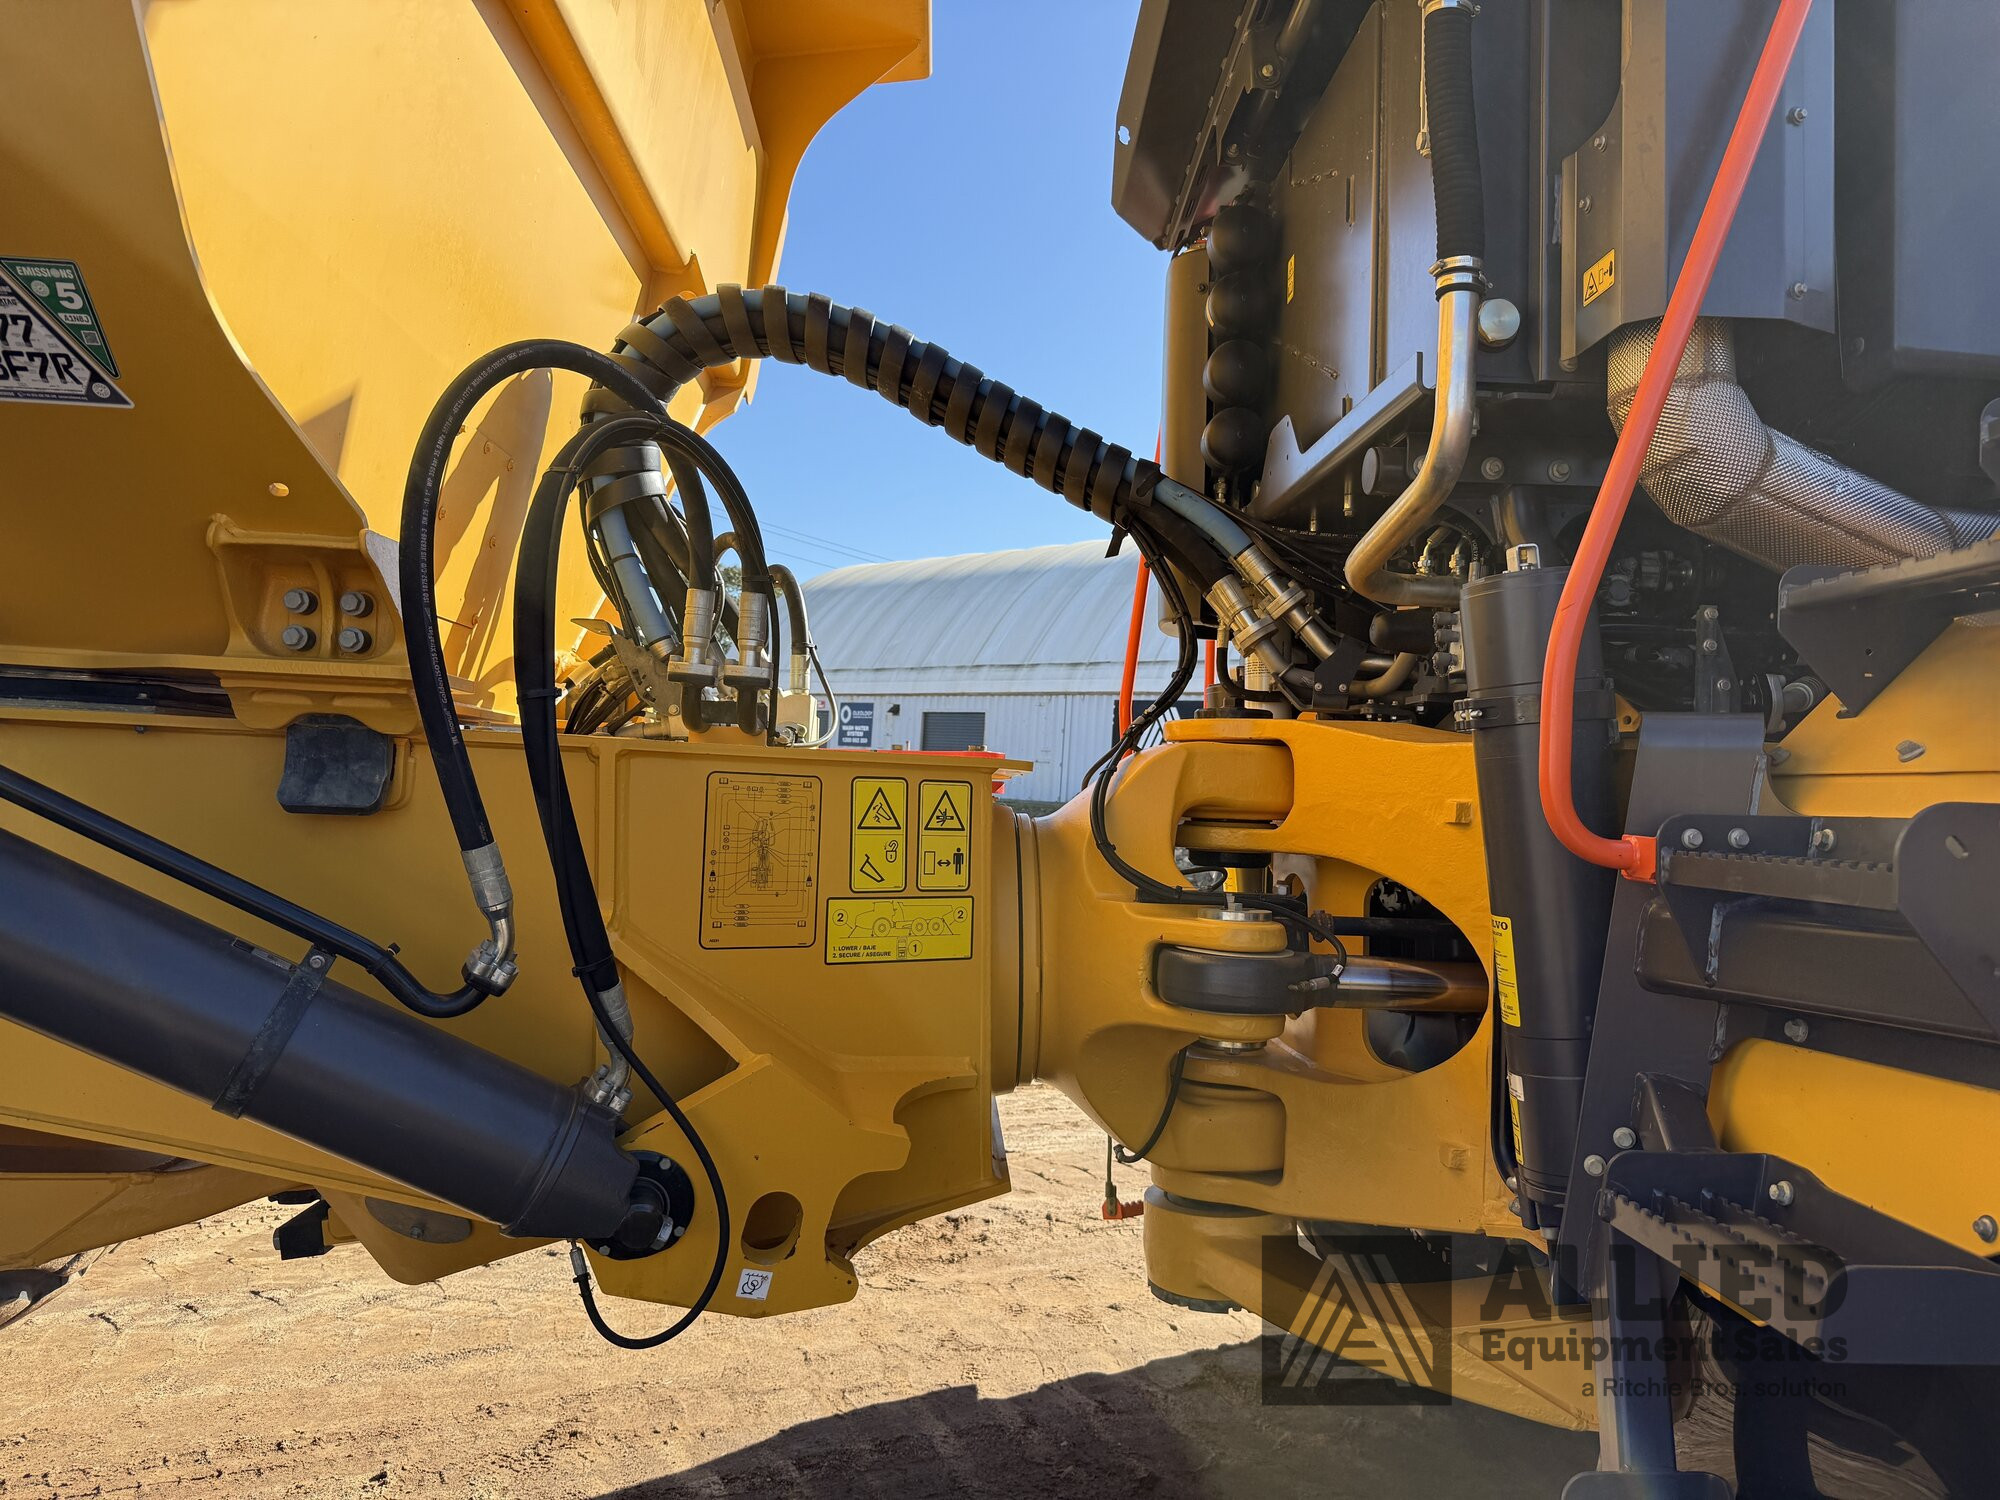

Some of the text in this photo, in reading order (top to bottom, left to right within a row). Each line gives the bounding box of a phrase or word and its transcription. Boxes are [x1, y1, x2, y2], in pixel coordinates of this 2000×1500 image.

[16, 266, 74, 279] EMISSIONS
[56, 282, 83, 310] 5
[837, 913, 844, 922] 2
[957, 910, 964, 919] 2
[1492, 920, 1508, 930] LVO
